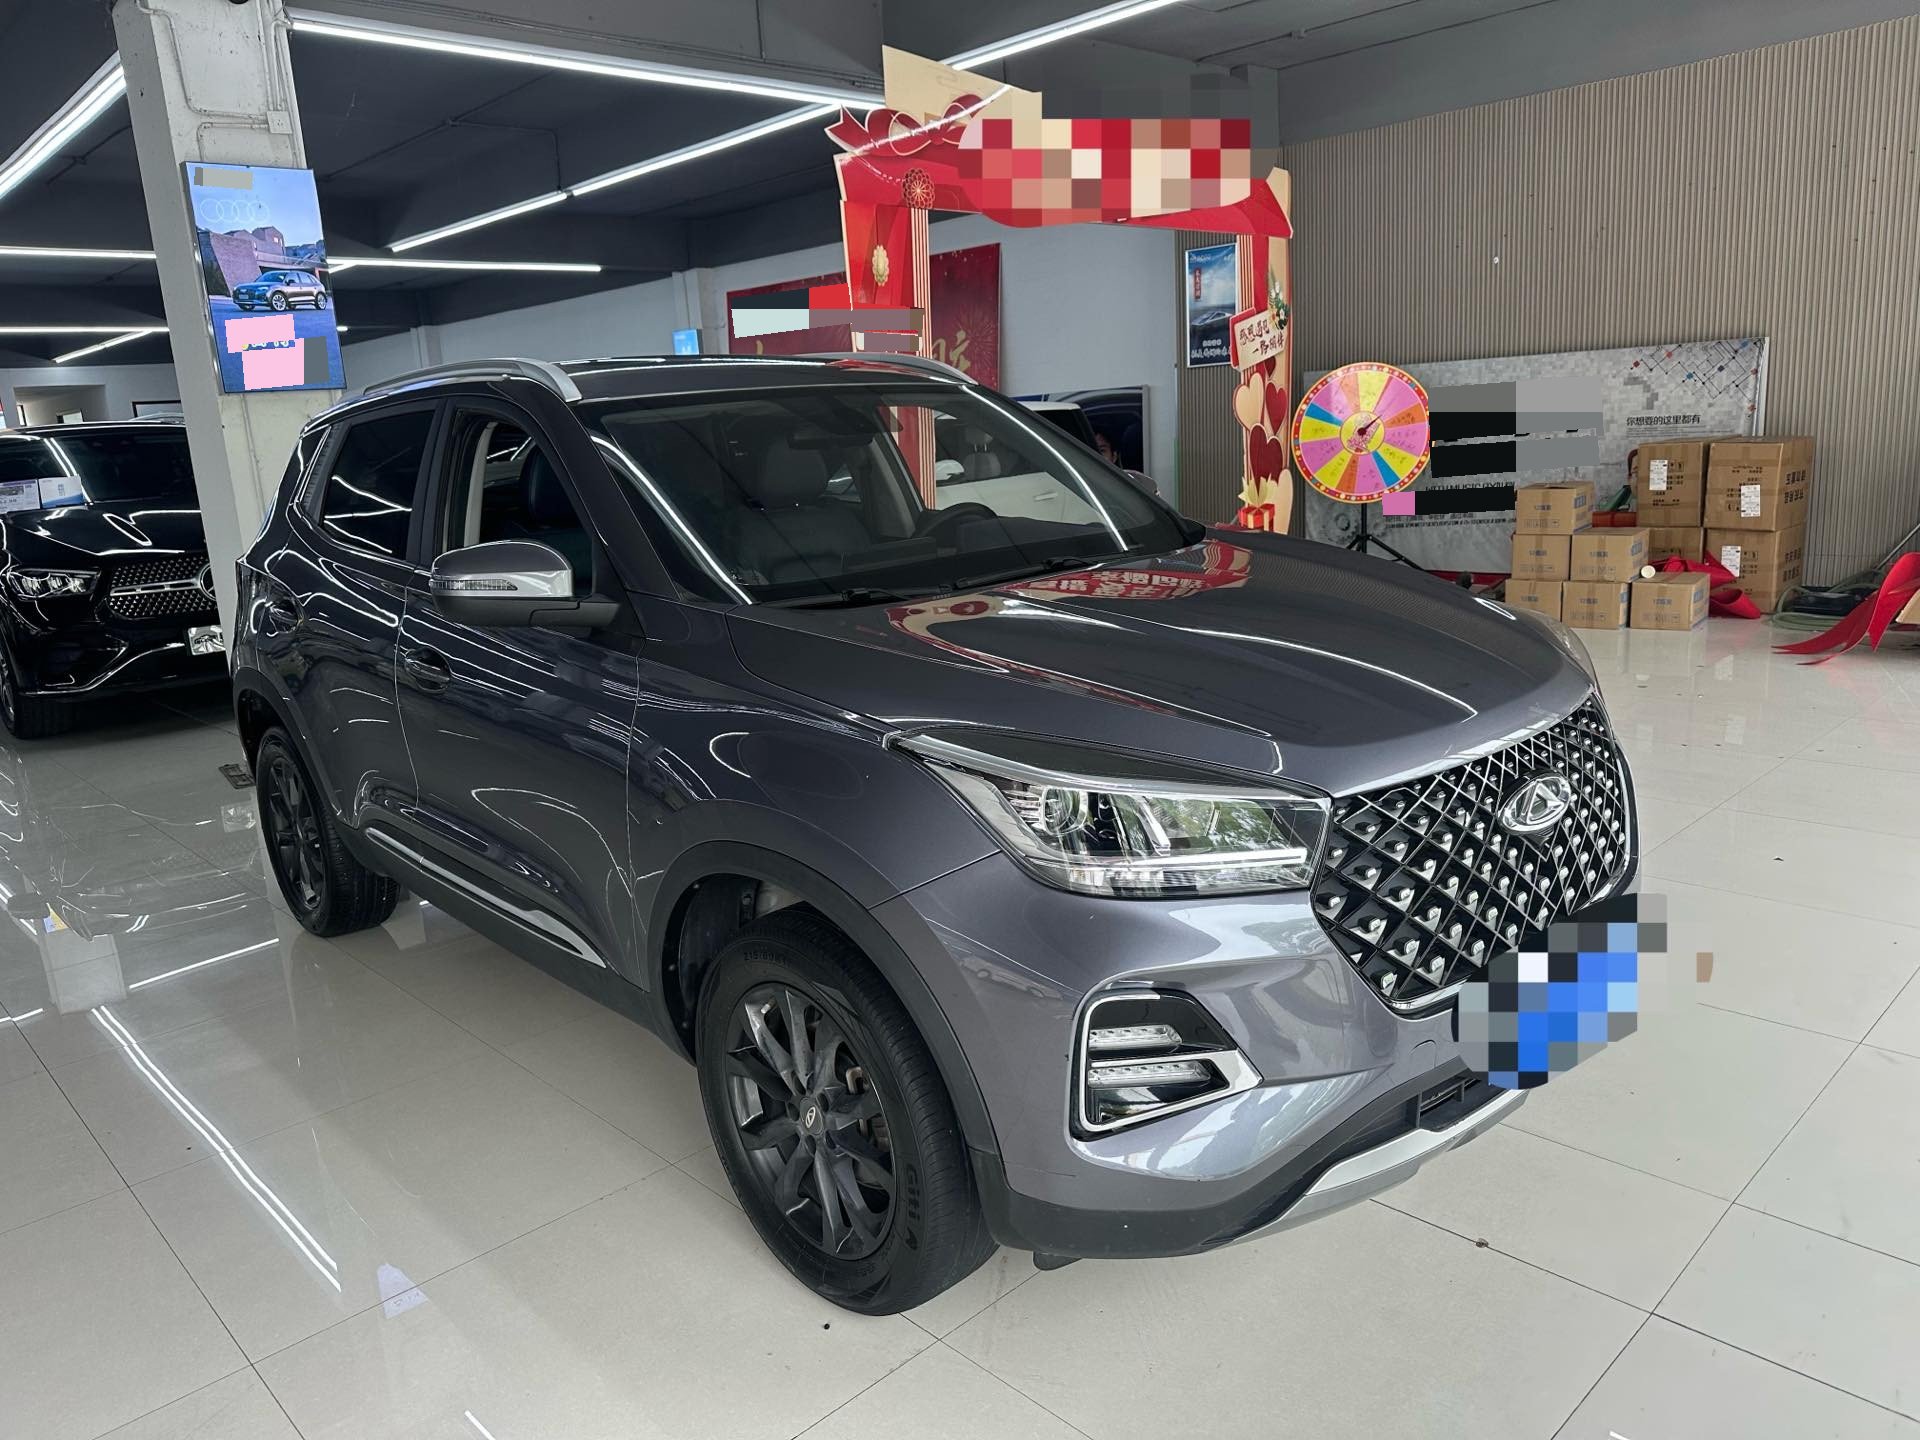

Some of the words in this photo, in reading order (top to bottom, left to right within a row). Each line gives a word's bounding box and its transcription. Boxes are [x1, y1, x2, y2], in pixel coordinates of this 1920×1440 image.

[1626, 414, 1701, 426] 你想要的这里都有
[906, 1163, 920, 1222] Giti
